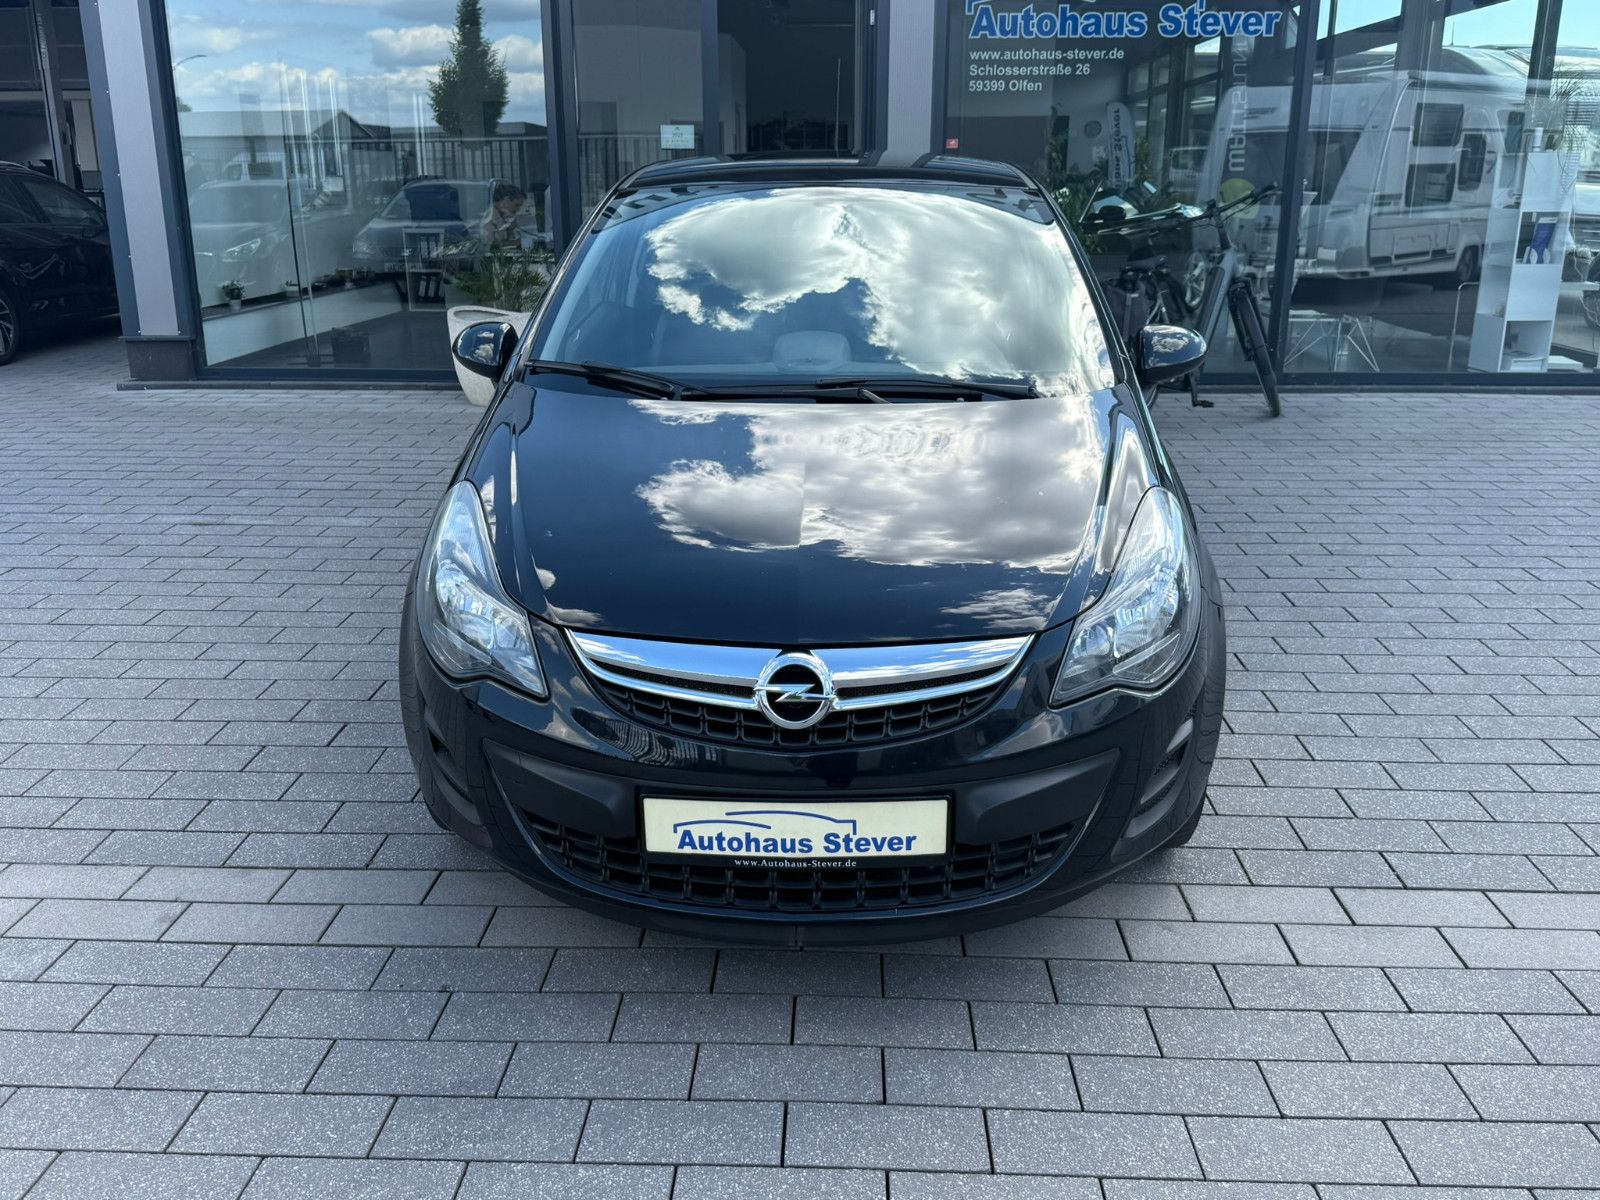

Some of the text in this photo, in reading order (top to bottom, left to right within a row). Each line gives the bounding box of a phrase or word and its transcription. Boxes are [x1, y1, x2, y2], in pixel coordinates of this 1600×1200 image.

[969, 3, 1282, 39] Autohaus Stever
[969, 48, 1125, 60] www.autohaus-stever.de
[969, 64, 1091, 76] Schlosserstraße 26
[968, 80, 1042, 92] 59399 Olfen
[677, 829, 917, 854] Autohaus Stever
[733, 858, 857, 868] www.Autohaus-Stever.de
